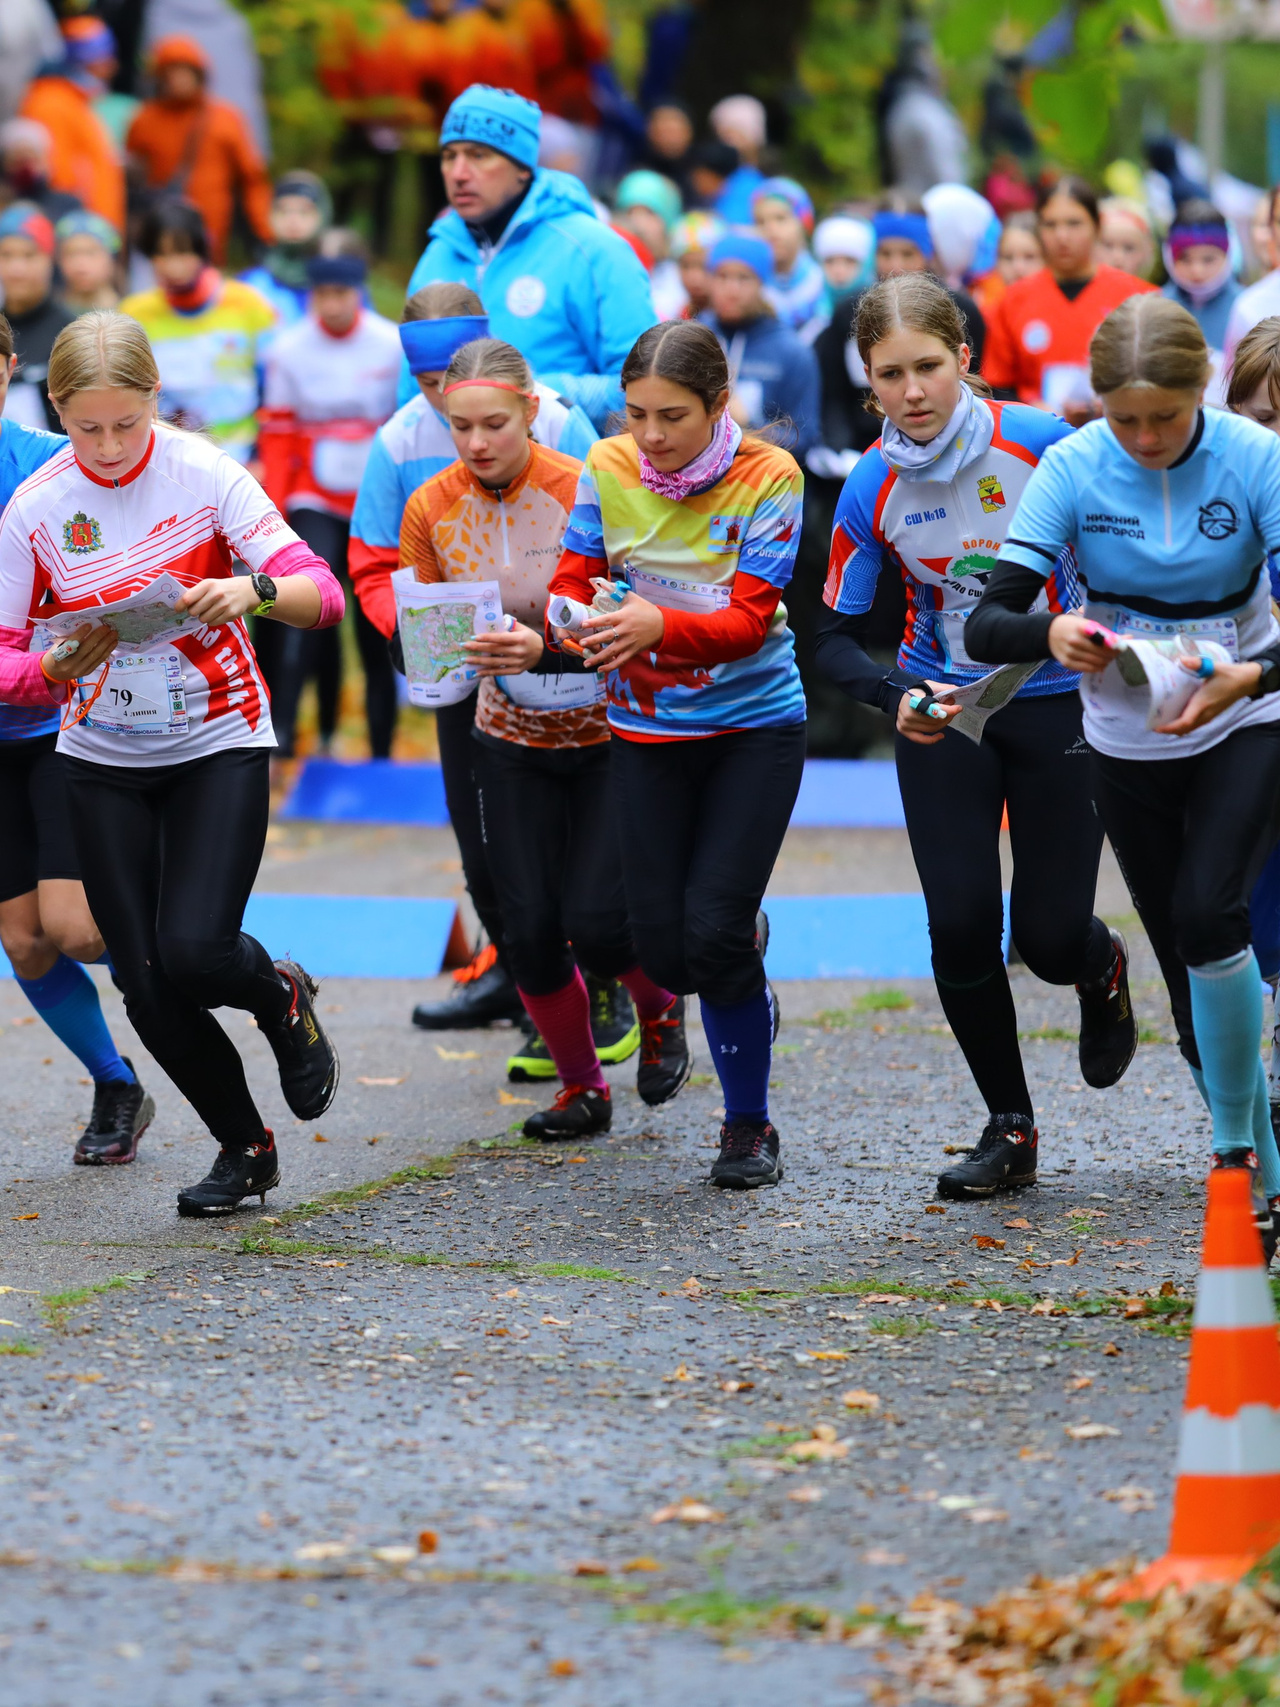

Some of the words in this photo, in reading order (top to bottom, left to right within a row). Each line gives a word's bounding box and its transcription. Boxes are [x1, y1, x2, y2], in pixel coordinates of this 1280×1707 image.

[904, 513, 923, 527] СШ
[923, 507, 947, 522] №18
[1086, 513, 1140, 527] НИЖНИЙ
[1082, 524, 1145, 541] НОВГОРОД
[962, 538, 1002, 552] ВОРОН
[214, 646, 250, 708] think
[109, 688, 133, 707] 79
[130, 709, 157, 717] линия
